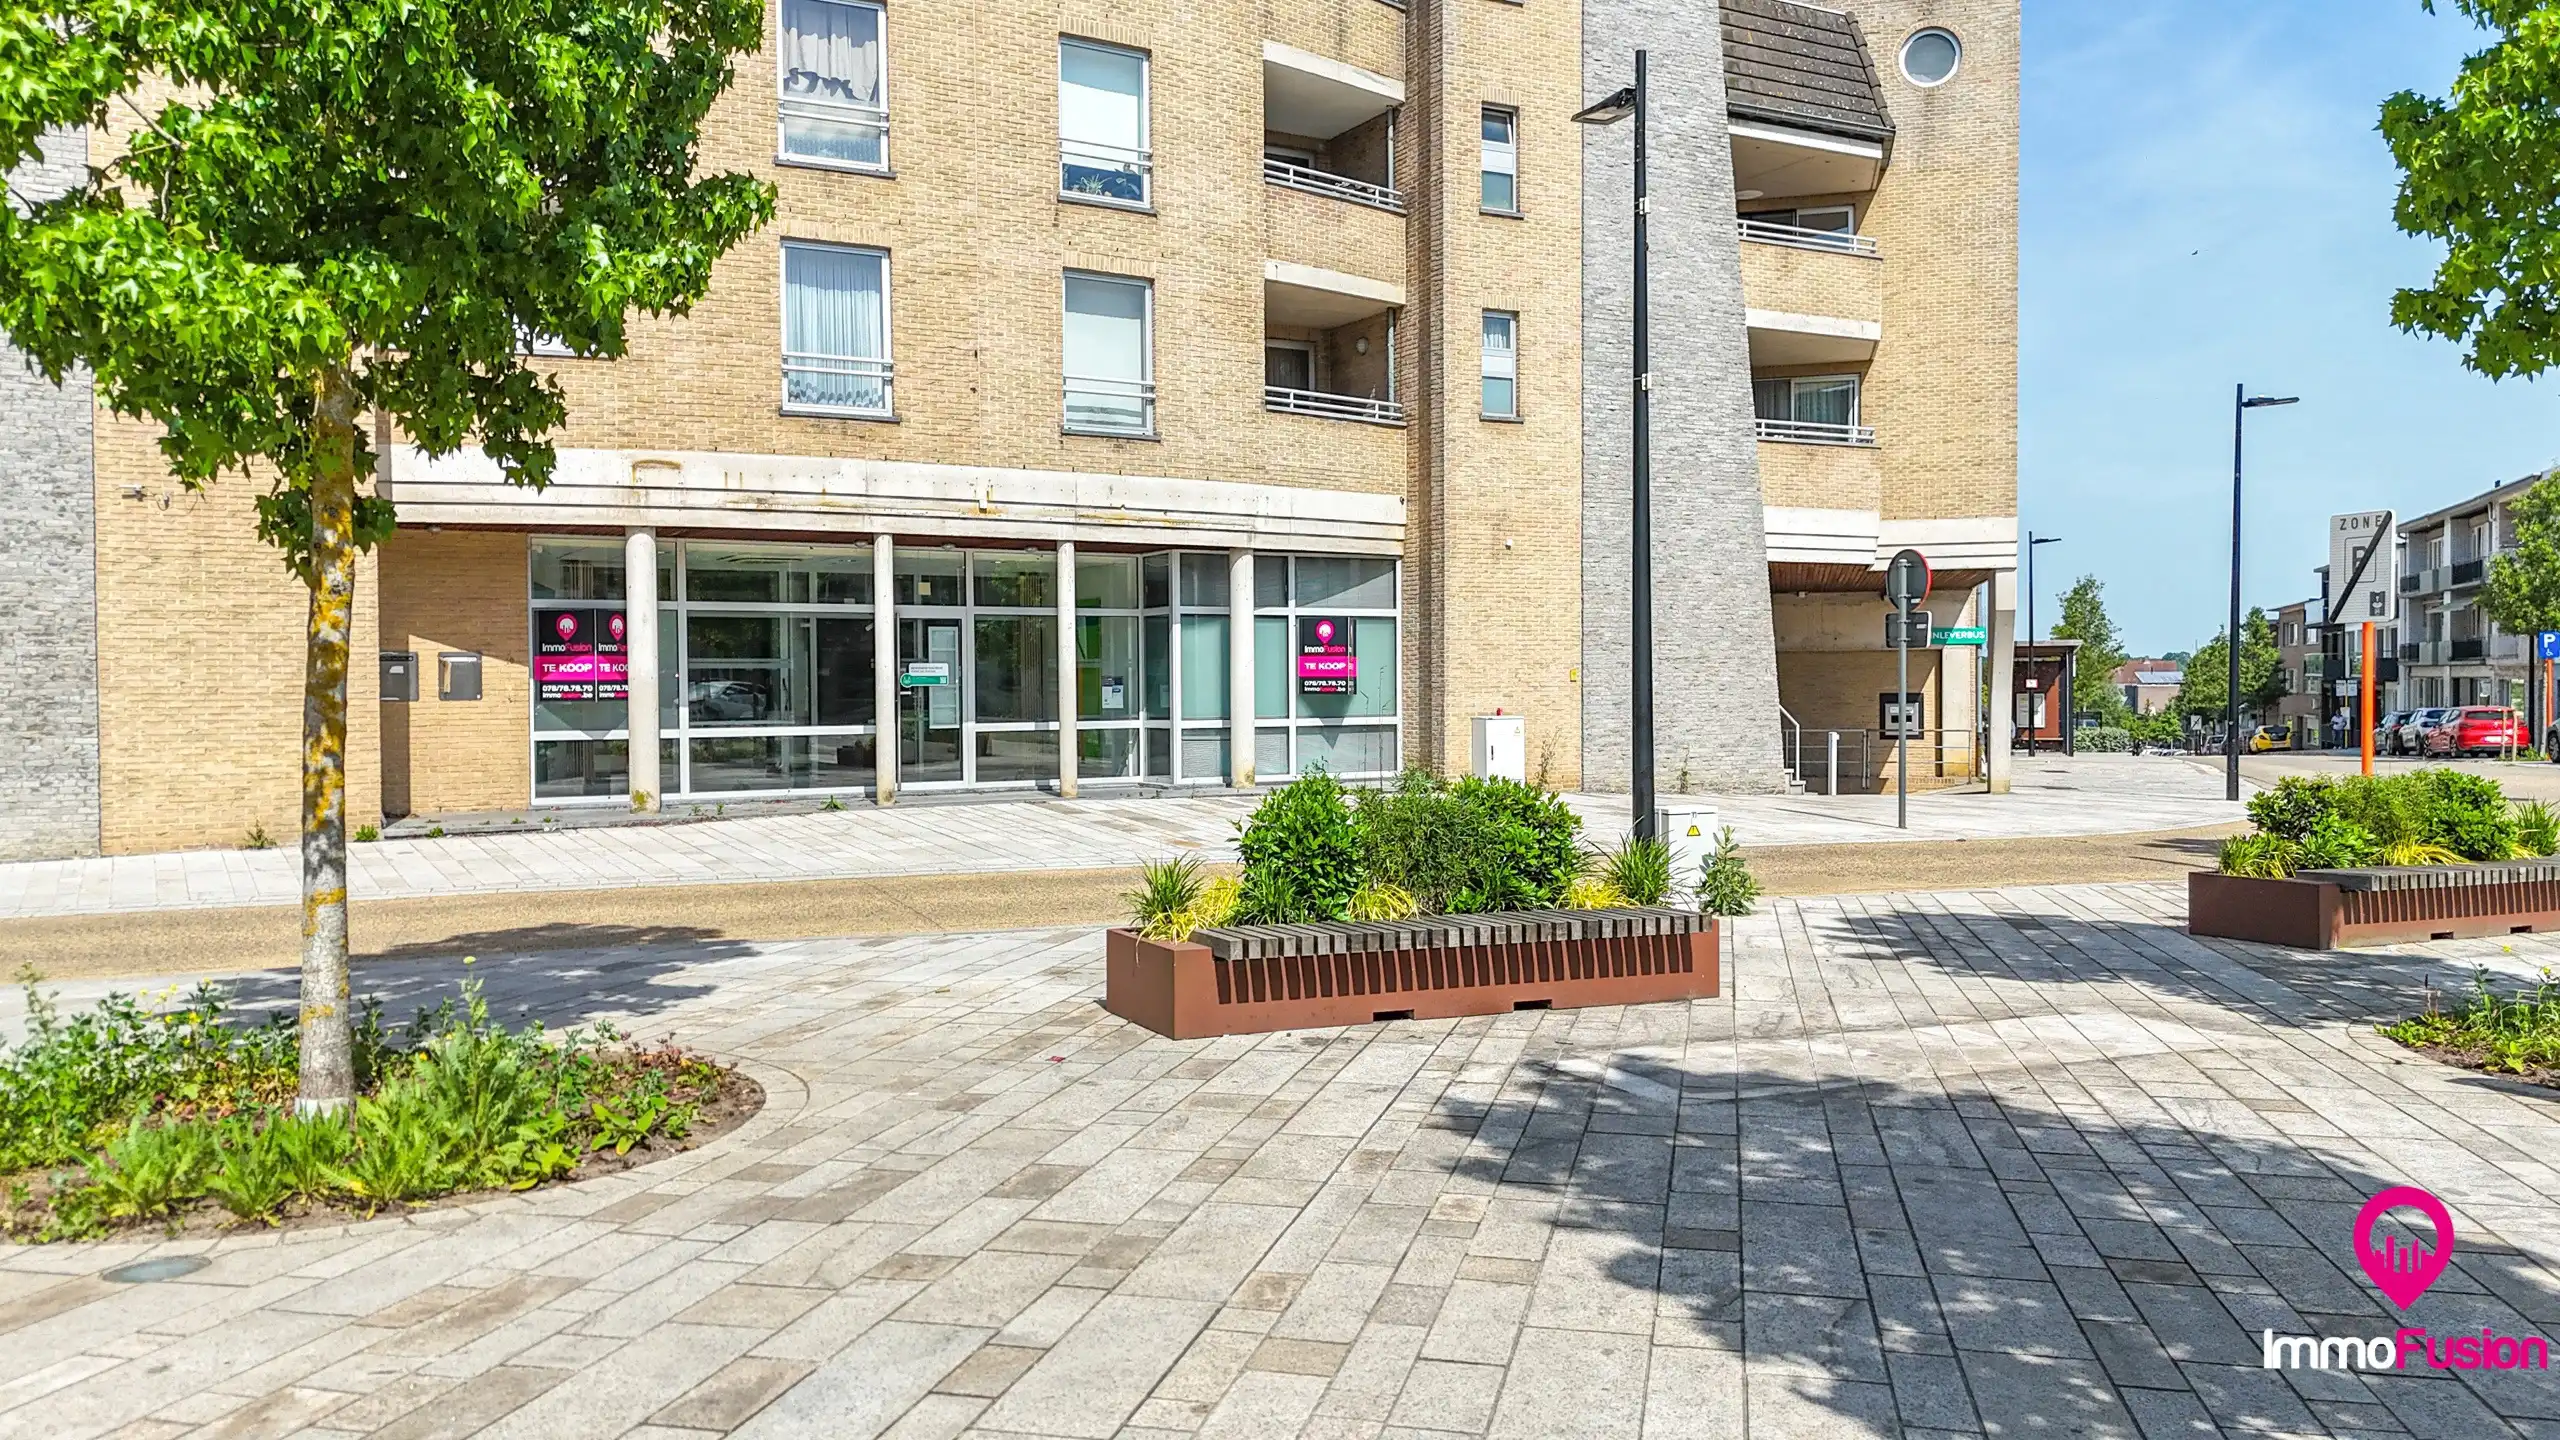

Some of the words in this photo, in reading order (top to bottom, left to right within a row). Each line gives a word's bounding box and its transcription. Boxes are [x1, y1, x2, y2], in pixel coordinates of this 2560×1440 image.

[2340, 515, 2383, 531] ZONE
[2352, 546, 2369, 575] P
[1932, 631, 1985, 640] NLEVERBUS
[2543, 633, 2556, 648] P
[542, 643, 593, 652] ImmoFusion
[1304, 645, 1346, 653] ImmoFusion
[542, 663, 556, 672] TE
[558, 663, 593, 672] KOOP
[598, 663, 610, 672] TE
[612, 663, 629, 672] KOO
[1304, 662, 1317, 670] TE
[1318, 662, 1346, 670] KOOP
